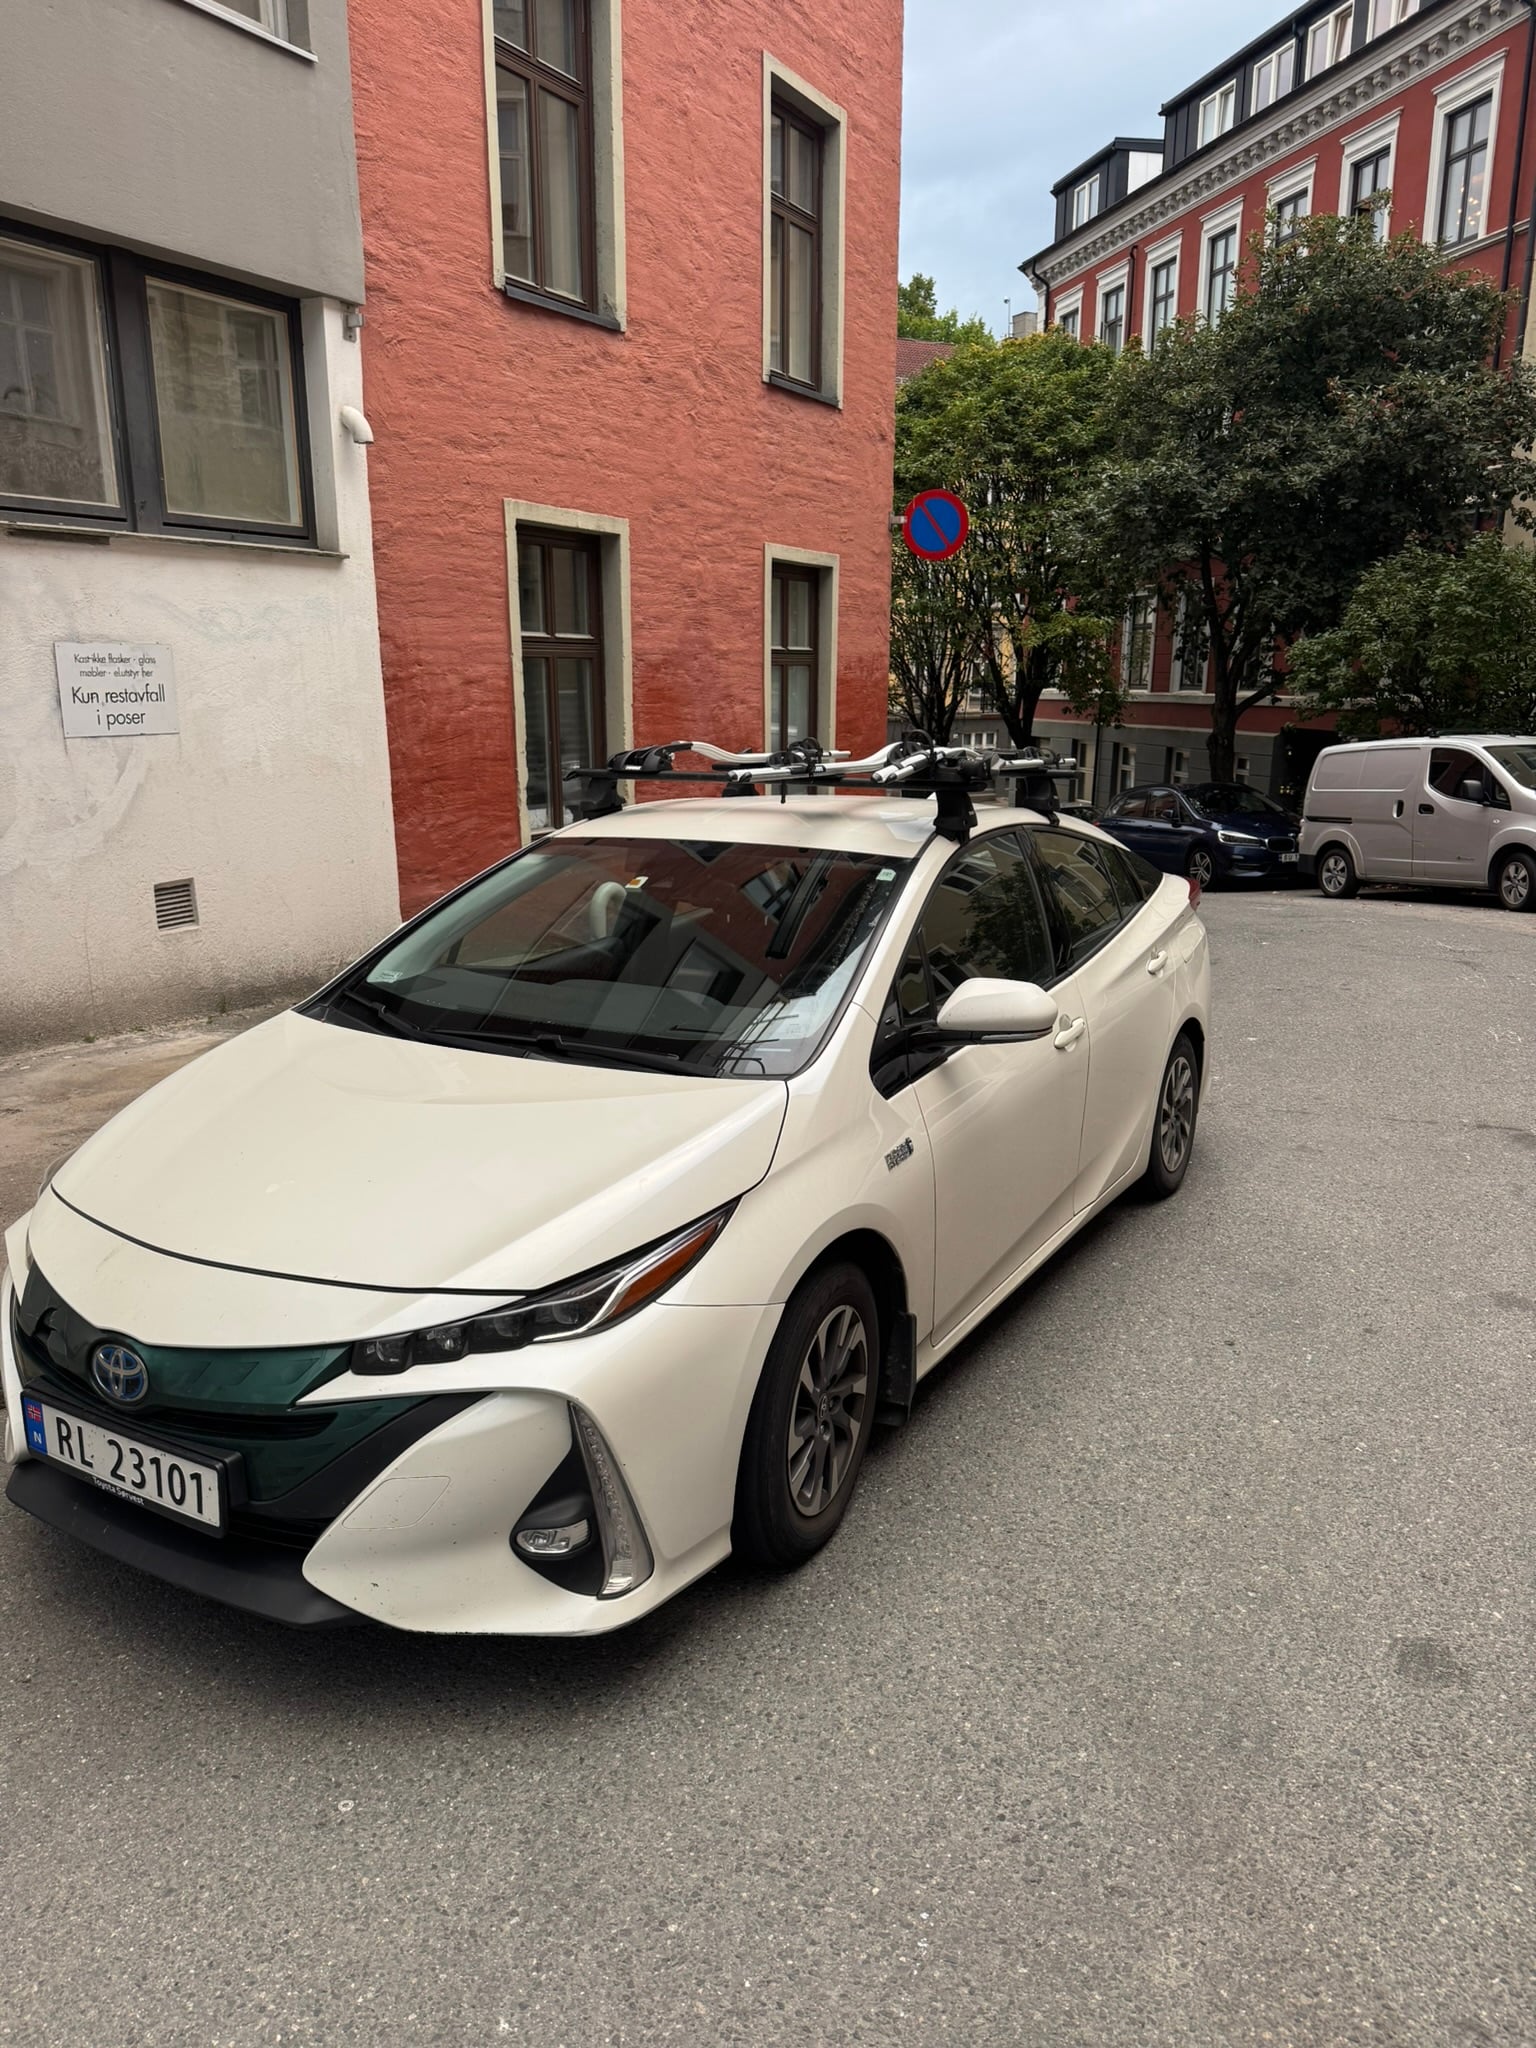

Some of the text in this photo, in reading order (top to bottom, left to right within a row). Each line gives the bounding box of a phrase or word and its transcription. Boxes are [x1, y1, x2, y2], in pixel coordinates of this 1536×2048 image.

[74, 653, 156, 666] Kast ikke flasker glass
[79, 667, 106, 677] møbler
[142, 667, 153, 677] her
[71, 683, 165, 704] Kun restavfall
[96, 709, 146, 731] i poser
[33, 1431, 42, 1445] N
[55, 1416, 203, 1516] RL 23101
[92, 1476, 116, 1493] Toyota
